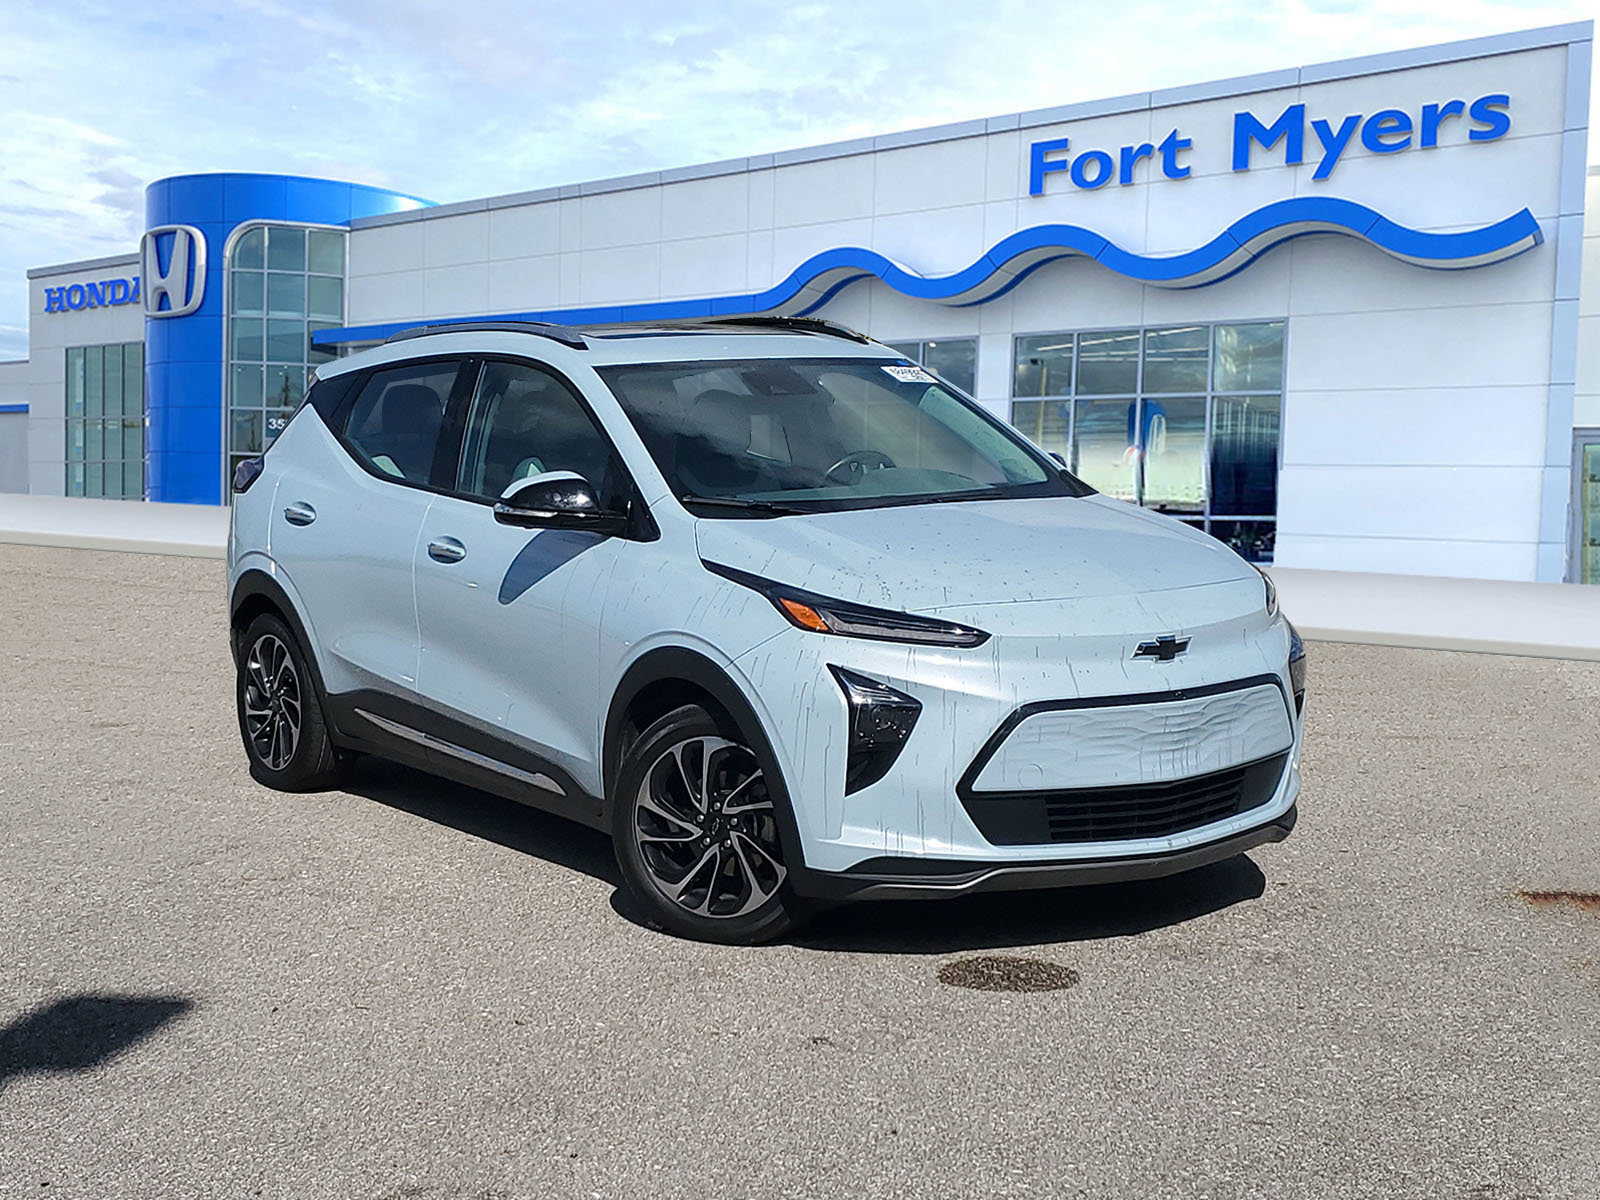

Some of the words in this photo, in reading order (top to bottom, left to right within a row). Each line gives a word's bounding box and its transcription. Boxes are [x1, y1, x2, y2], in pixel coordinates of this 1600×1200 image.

[1028, 128, 1193, 197] Fort
[1232, 92, 1512, 181] Myers
[268, 417, 288, 430] 35
